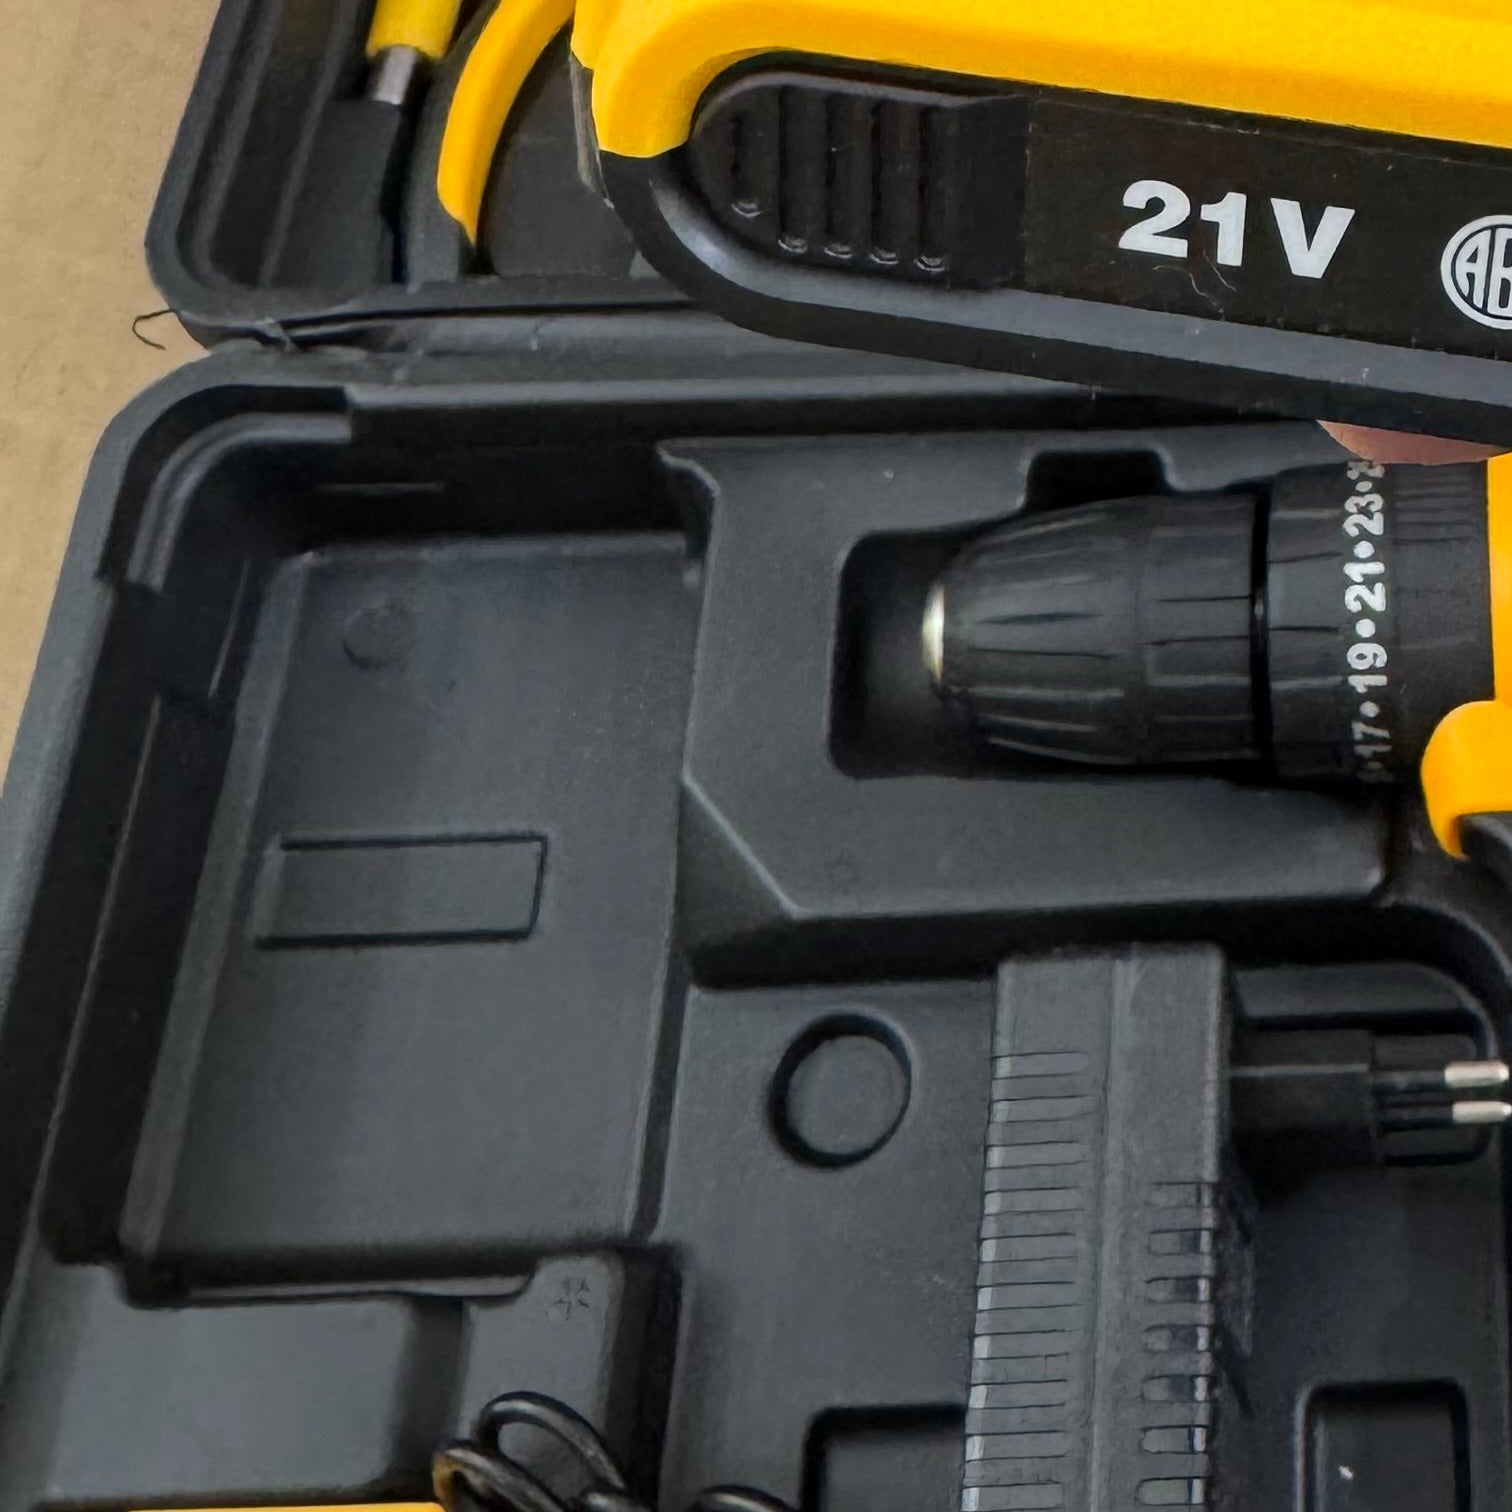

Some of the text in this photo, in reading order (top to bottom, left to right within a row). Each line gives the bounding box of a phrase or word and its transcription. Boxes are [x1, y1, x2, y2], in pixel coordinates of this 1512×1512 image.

[1342, 491, 1385, 538] 23
[1342, 560, 1387, 613] 21
[1346, 642, 1389, 694] 19
